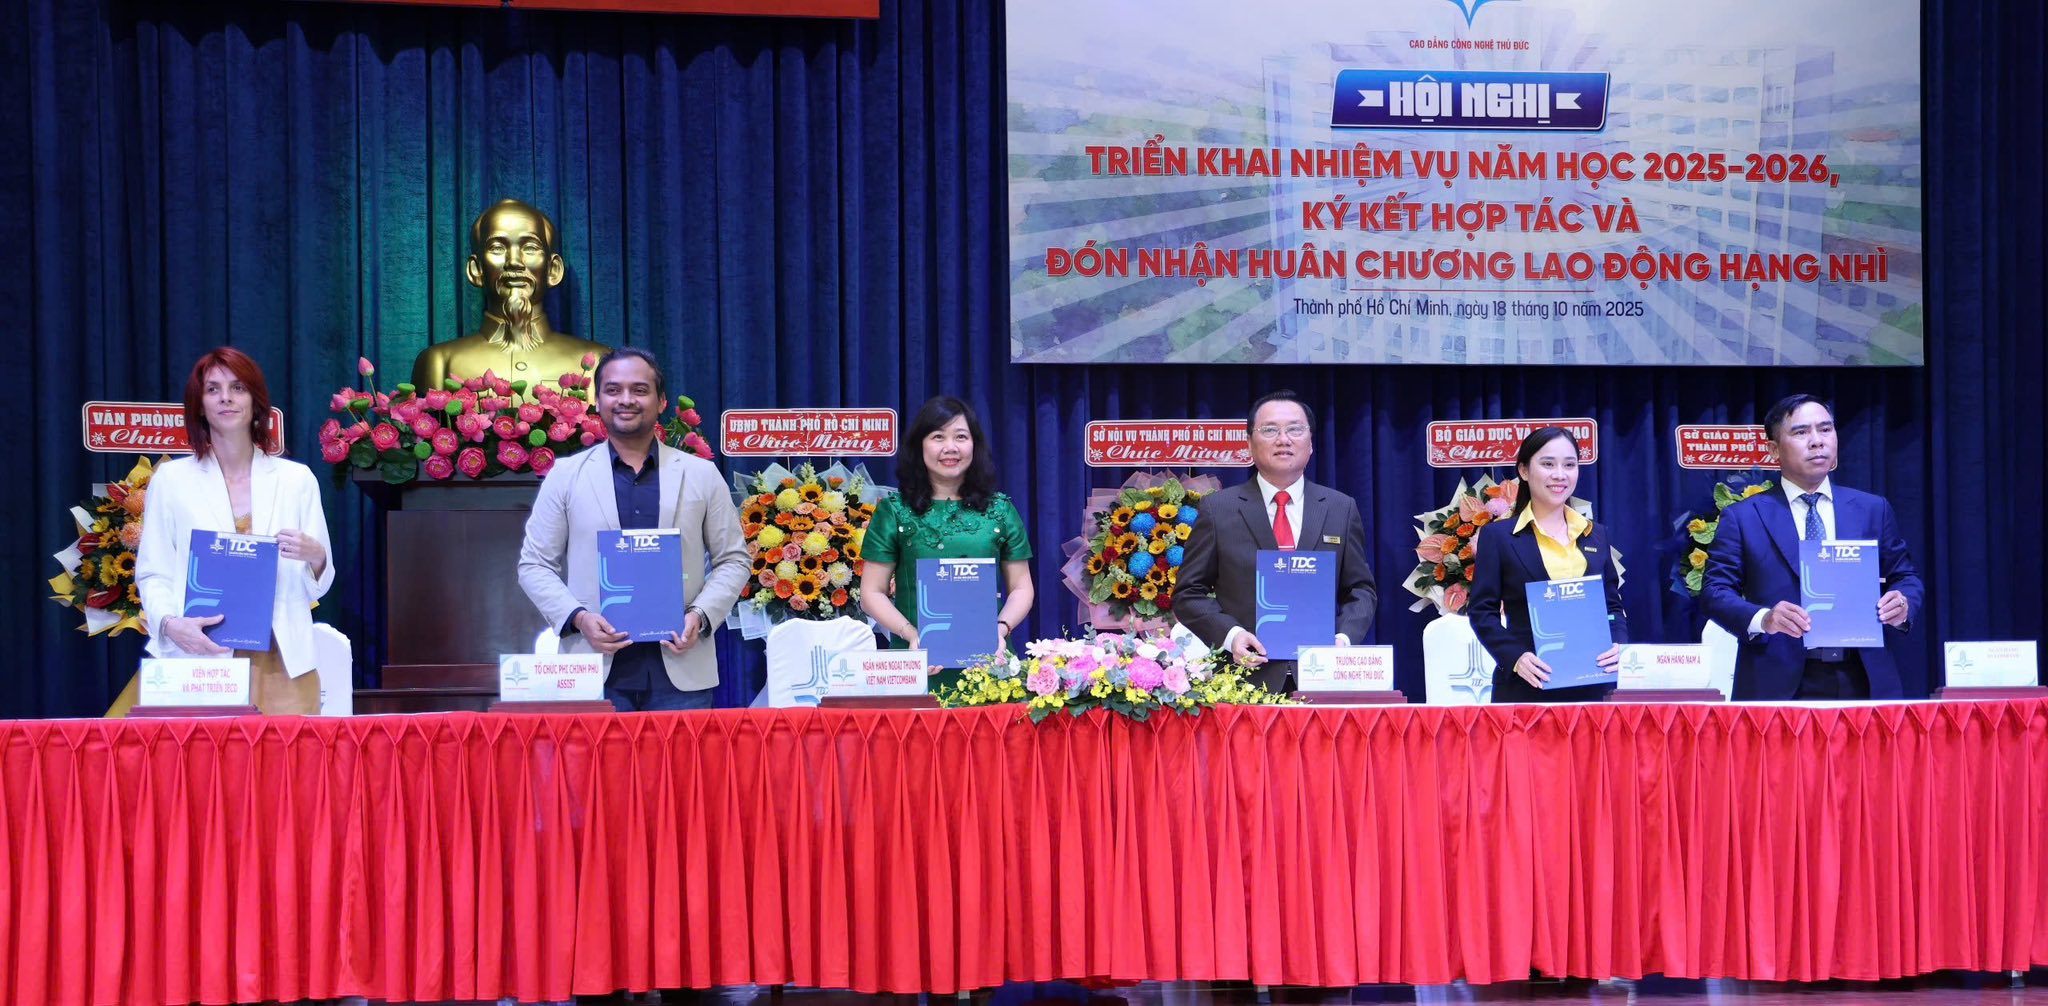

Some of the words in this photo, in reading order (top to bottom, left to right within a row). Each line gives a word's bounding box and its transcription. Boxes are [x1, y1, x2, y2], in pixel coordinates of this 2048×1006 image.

[1409, 40, 1424, 48] CAO
[1427, 36, 1448, 49] ĐẲNG
[1451, 38, 1472, 49] CÔNG
[1474, 39, 1494, 51] NGHỆ
[1497, 38, 1511, 50] THỦ
[1513, 39, 1529, 50] ĐỨC
[1389, 74, 1452, 122] HỘI
[1461, 82, 1551, 124] NGHỊ
[1085, 134, 1188, 177] TRIỂN
[1197, 148, 1281, 177] KHAI
[1290, 142, 1402, 186] NHIỆM
[1411, 150, 1460, 188] VỤ
[1469, 144, 1547, 181] NĂM
[1556, 152, 1635, 189] HỌC
[1644, 153, 1839, 188] 2025-2026,
[1302, 194, 1351, 231] KÝ
[1359, 192, 1423, 231] KẾT
[1432, 202, 1507, 240] HỢP
[1515, 197, 1584, 233] TÁC
[1592, 197, 1641, 234] VÀ
[1045, 240, 1128, 278] ĐÓN
[1137, 242, 1239, 287] NHẬN
[1248, 243, 1347, 279] HUÂN
[1355, 250, 1515, 281] CHƯƠNG
[1524, 252, 1595, 281] LAO
[1603, 245, 1711, 290] ĐỘNG
[1720, 254, 1820, 291] HẠNG
[1829, 247, 1888, 282] NHÌ
[1293, 298, 1333, 315] Thành
[1338, 297, 1362, 318] phố
[1367, 297, 1384, 315] Hồ
[1389, 299, 1411, 315] Chí
[1457, 300, 1488, 319] ngày
[1493, 300, 1507, 316] 18
[1512, 300, 1549, 319] tháng
[1553, 301, 1567, 316] 10
[1573, 301, 1600, 317] năm
[1605, 301, 1644, 317] 2025
[93, 410, 125, 425] VĂN
[131, 410, 185, 427] PHÒNG
[729, 418, 757, 432] UBND
[761, 416, 797, 432] THÀNH
[800, 414, 820, 432] PHỐ
[824, 415, 838, 432] HỒ
[841, 416, 859, 432] CHÍ
[862, 418, 889, 431] MINH
[110, 429, 176, 445] Chúc
[743, 433, 800, 449] Chúc
[808, 433, 876, 452] Mừng
[1093, 426, 1105, 442] SỞ
[1108, 427, 1123, 445] NỘI
[1125, 430, 1137, 445] VỤ
[1139, 427, 1170, 442] THÀNH
[1172, 425, 1190, 442] PHỐ
[1193, 426, 1205, 441] HỒ
[1207, 427, 1222, 441] CHÍ
[1225, 429, 1248, 441] MINH
[1435, 426, 1451, 446] BỘ
[1456, 425, 1484, 442] GIÁO
[1488, 428, 1512, 445] DỤC
[1684, 429, 1699, 440] SỞ
[1703, 430, 1730, 440] GIÁO
[1733, 430, 1756, 441] DỤC
[1106, 445, 1162, 460] Chúc
[1166, 444, 1234, 462] Mừng
[1449, 445, 1504, 460] Chúc
[1687, 441, 1727, 451] THÀNH
[1731, 440, 1755, 451] PHỐ
[1698, 453, 1750, 463] Chúc
[230, 540, 258, 553] TDC
[633, 535, 660, 547] TDC
[1834, 546, 1860, 558] TDC
[953, 564, 979, 576] TDC
[1291, 556, 1317, 569] TDC
[1559, 582, 1584, 596] TDC
